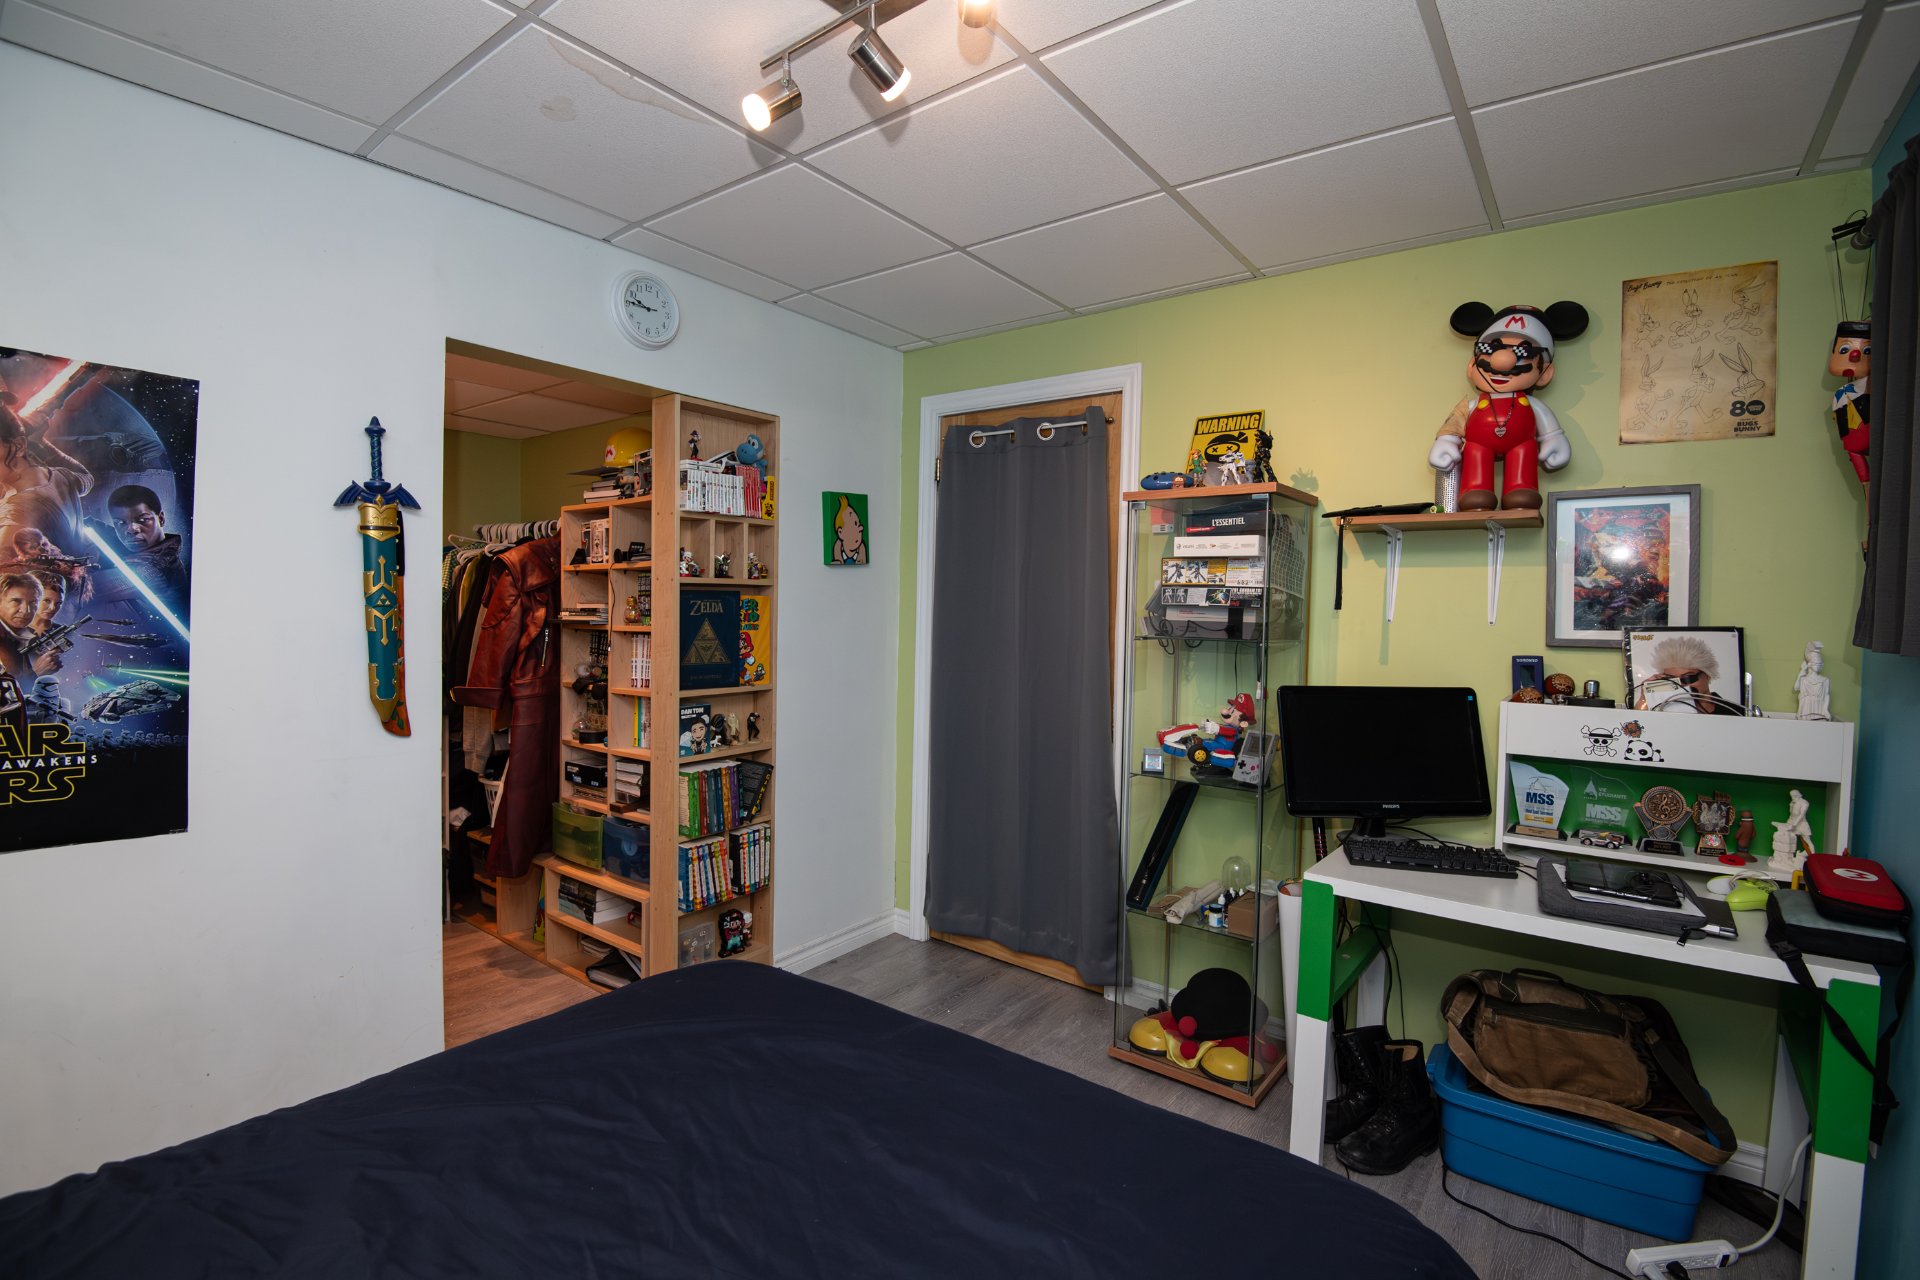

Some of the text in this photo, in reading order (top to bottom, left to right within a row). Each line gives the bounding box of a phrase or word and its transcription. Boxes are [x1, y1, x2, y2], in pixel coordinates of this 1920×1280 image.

[1505, 316, 1526, 329] M
[1197, 413, 1260, 434] WARNING
[1212, 517, 1246, 526] L'ESSENTIEL
[0, 723, 86, 758] AR
[2, 754, 98, 770] AWAKENS
[0, 766, 86, 805] RS
[1526, 791, 1555, 806] MSS
[1586, 803, 1622, 820] MSS
